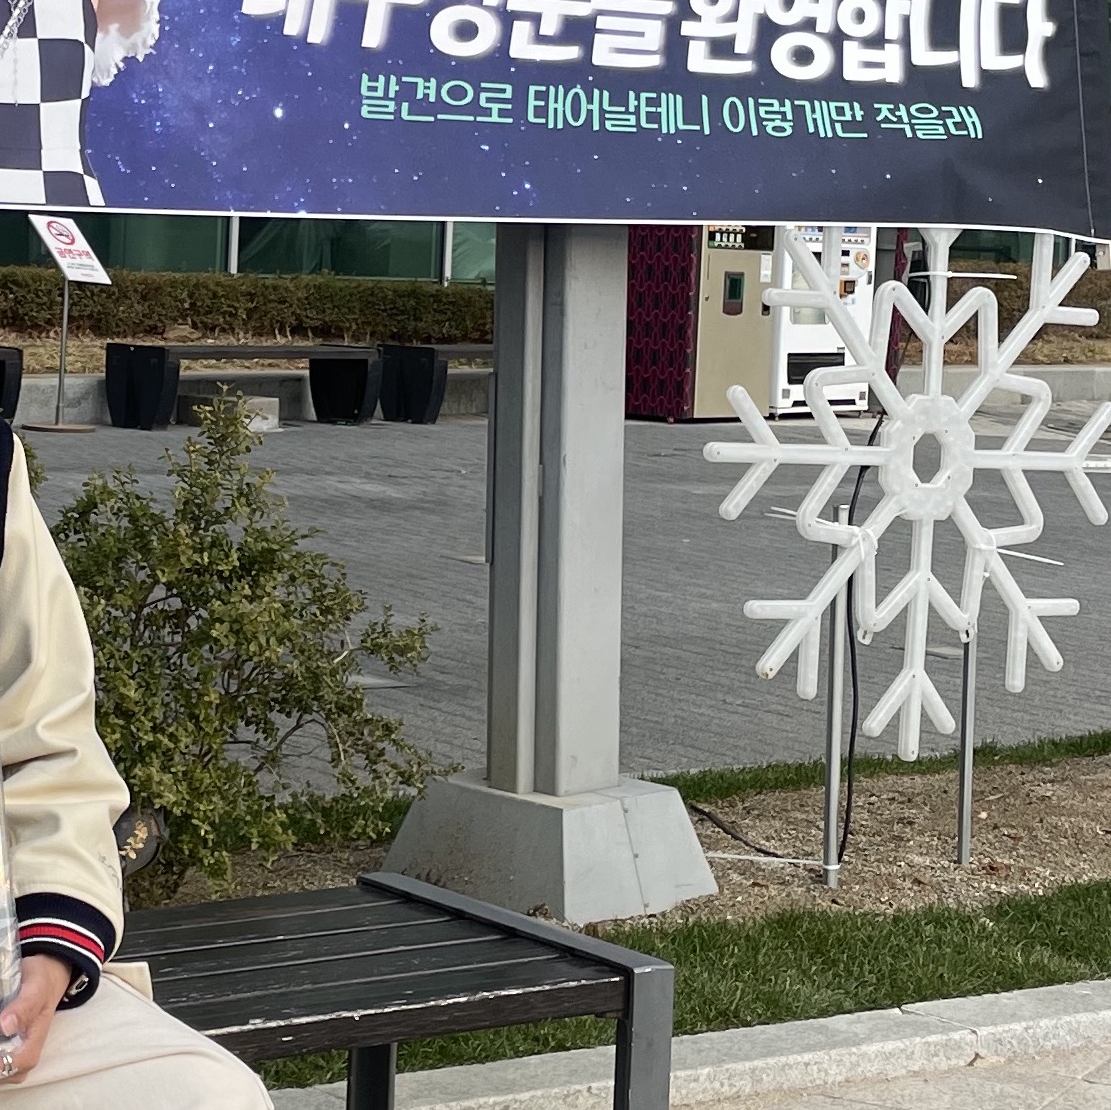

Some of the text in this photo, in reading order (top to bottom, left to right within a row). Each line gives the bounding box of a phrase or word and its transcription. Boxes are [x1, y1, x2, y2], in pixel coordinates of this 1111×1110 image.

[360, 73, 984, 140] 발견으로 태어날테니 이렇게만 적을래
